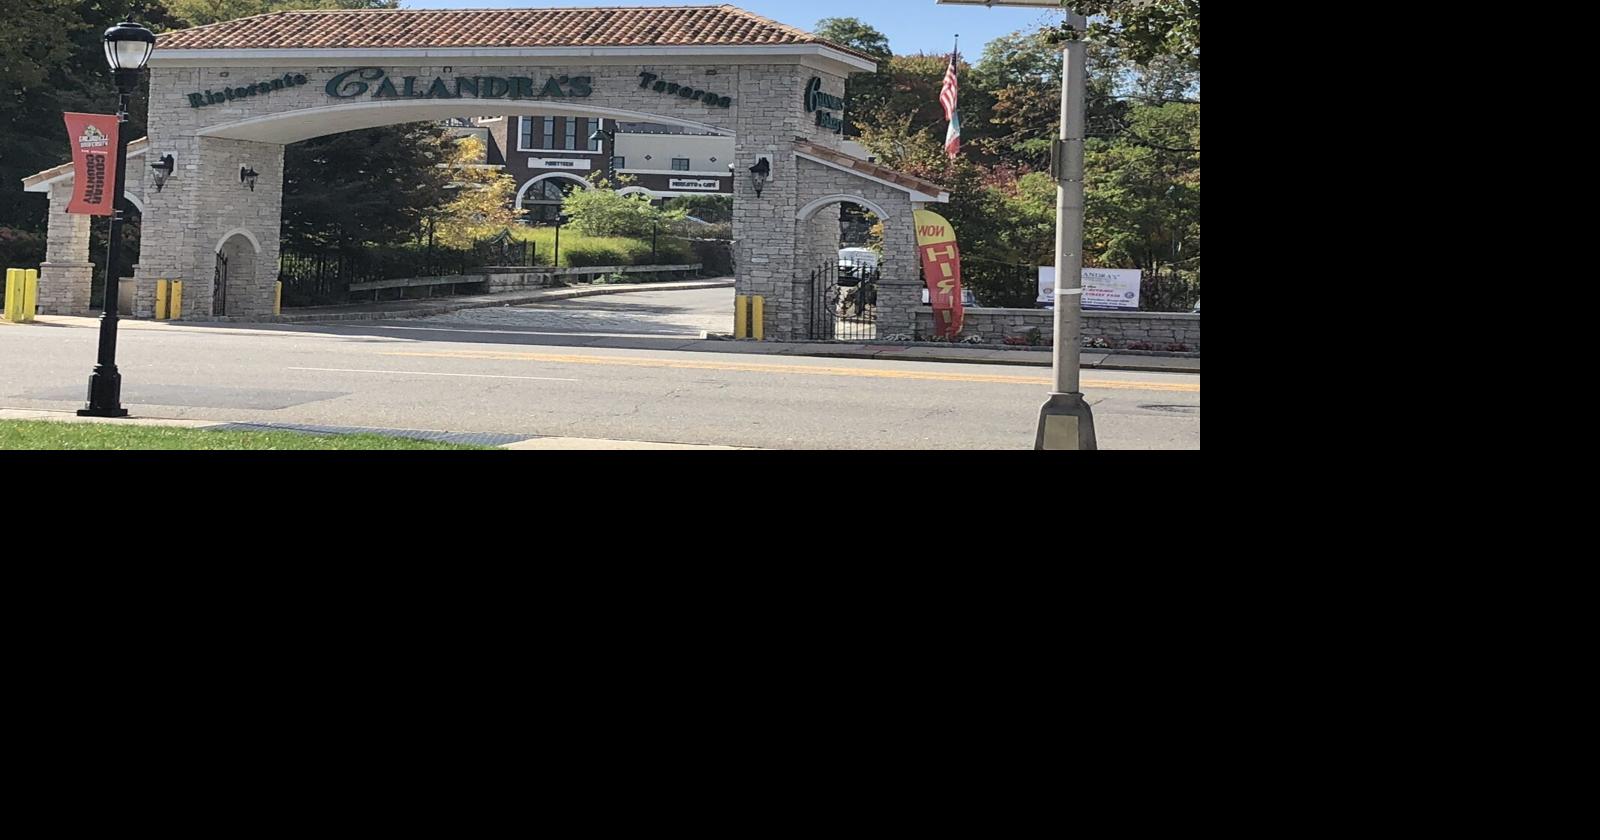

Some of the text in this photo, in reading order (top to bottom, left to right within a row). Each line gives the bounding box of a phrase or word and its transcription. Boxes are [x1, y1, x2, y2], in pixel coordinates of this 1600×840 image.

[188, 72, 307, 108] Ristorante
[325, 66, 592, 100] CALANDRA'S
[638, 70, 731, 109] Taverna
[83, 154, 96, 204] COUNTRY
[95, 154, 105, 204] COUGAR
